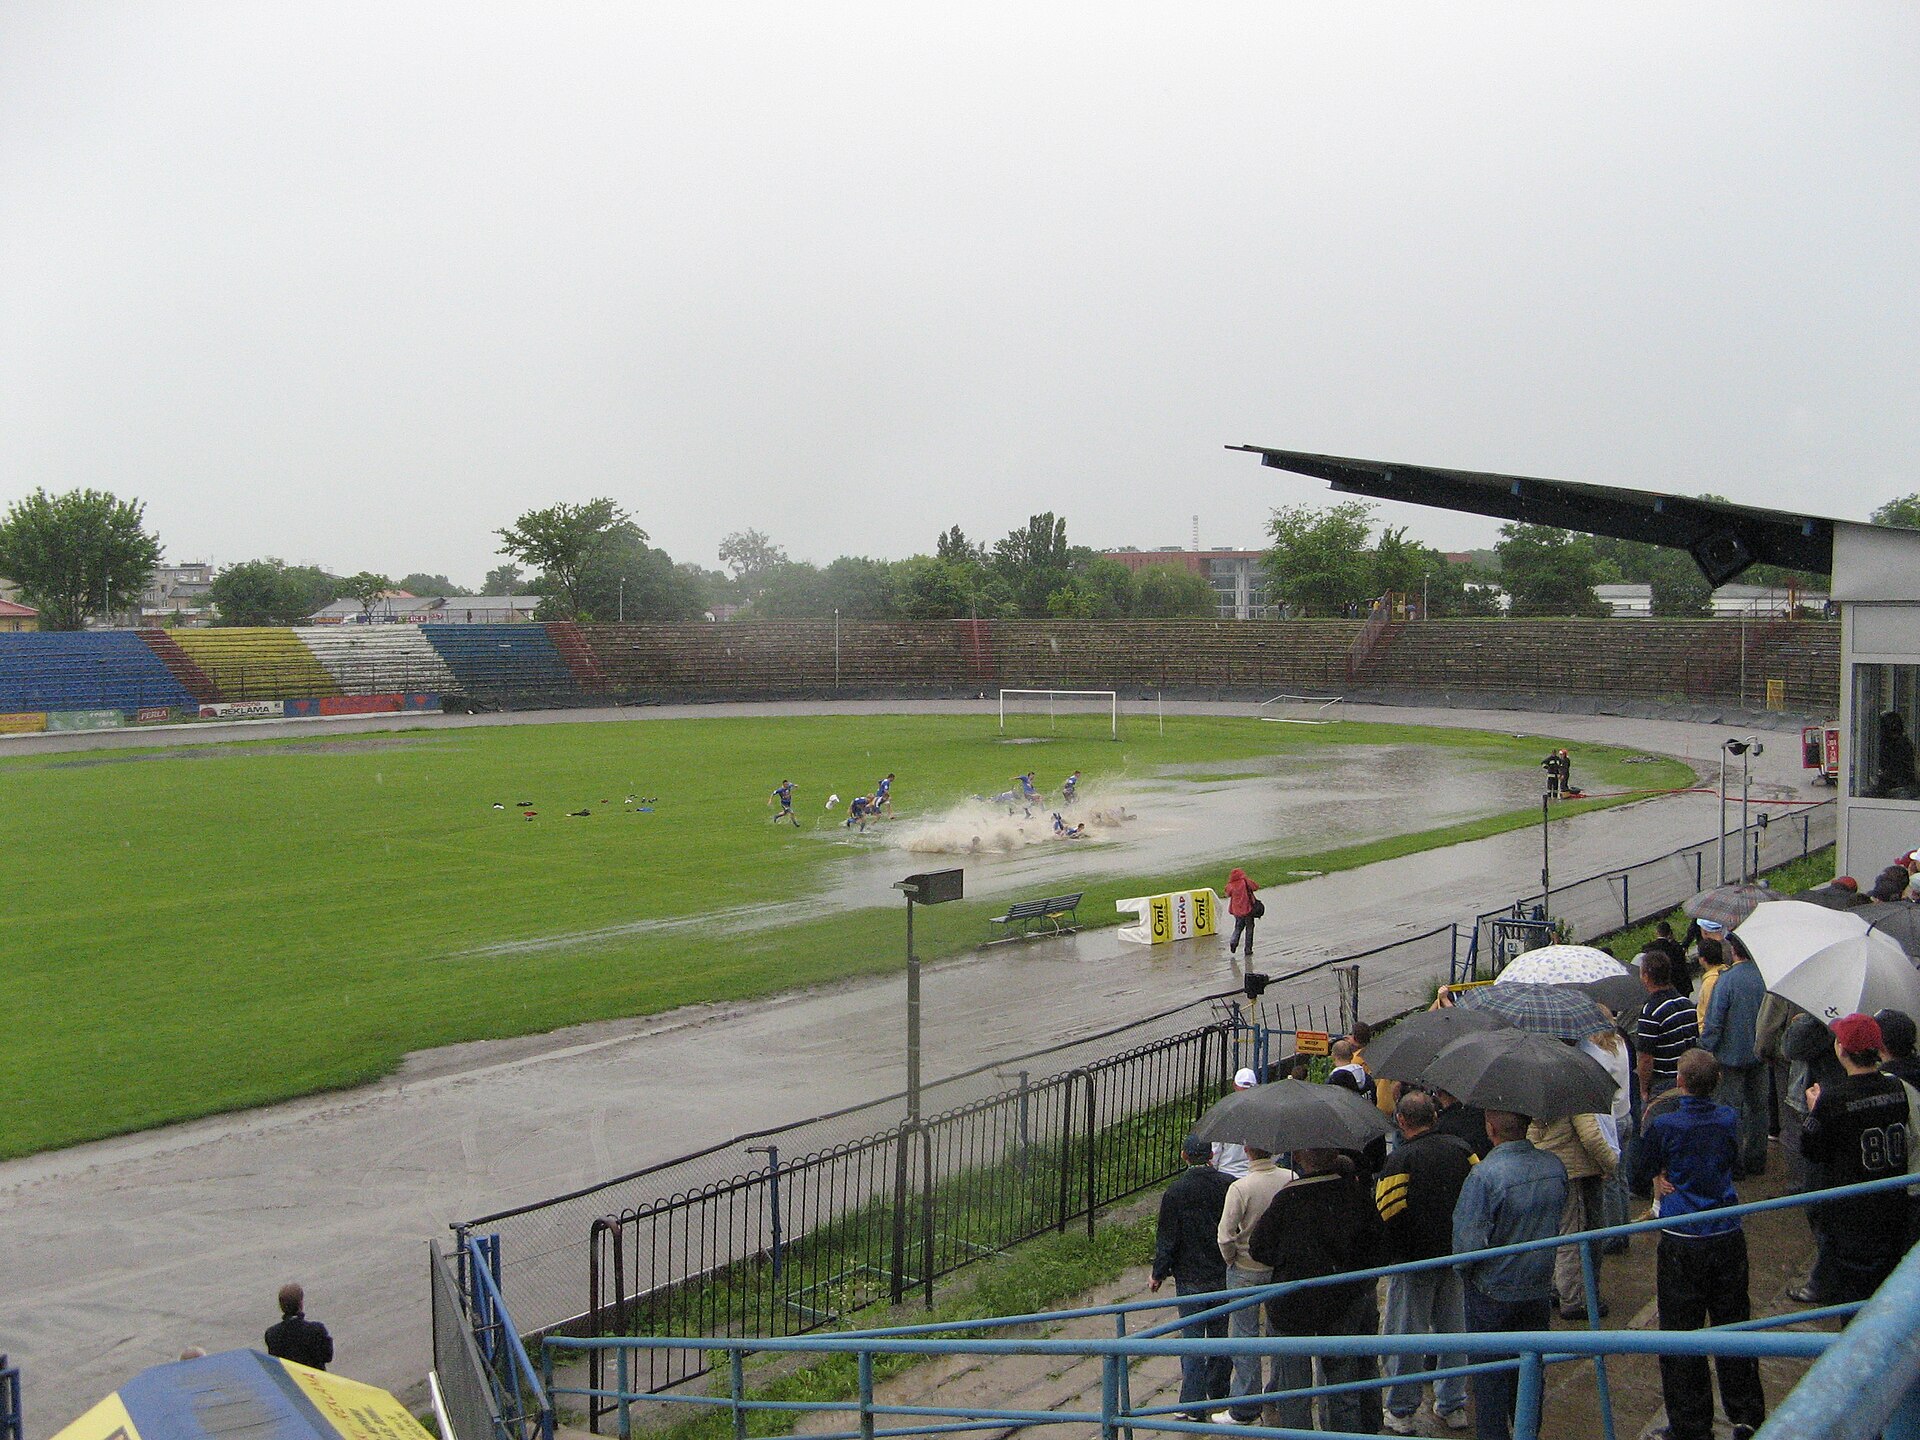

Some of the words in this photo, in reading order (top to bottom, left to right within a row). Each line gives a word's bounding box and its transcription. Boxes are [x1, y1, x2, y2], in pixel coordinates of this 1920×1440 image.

[220, 706, 270, 716] REKLAMA
[1178, 896, 1187, 935] OLIMP
[1861, 1122, 1907, 1170] 80
